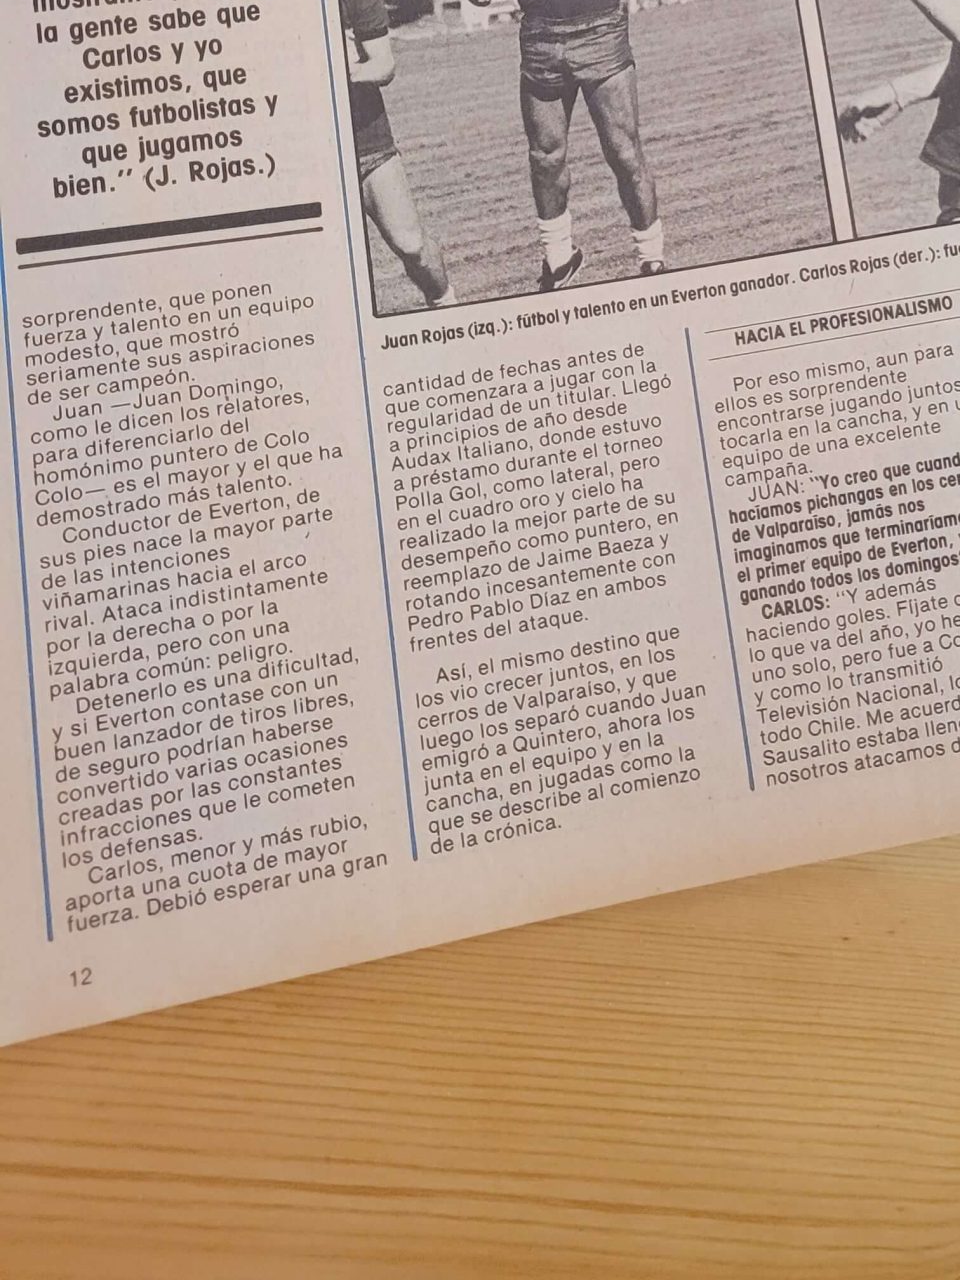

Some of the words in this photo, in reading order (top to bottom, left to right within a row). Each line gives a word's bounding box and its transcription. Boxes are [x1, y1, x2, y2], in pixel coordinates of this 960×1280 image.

[36, 22, 59, 44] la
[69, 15, 138, 46] gente
[148, 7, 206, 32] sabe
[216, 4, 261, 29] que
[82, 43, 162, 70] Carlos
[170, 41, 185, 65] y
[193, 38, 223, 62] yo
[64, 74, 192, 104] existimos,
[202, 67, 247, 93] que
[37, 112, 121, 138] somos
[128, 97, 256, 128] futbolistas
[264, 94, 278, 118] y
[81, 143, 128, 169] que
[138, 129, 243, 164] jugamos
[188, 152, 276, 184] Rojas.)
[380, 333, 419, 350] Juan
[421, 325, 465, 345] Rojas
[516, 308, 560, 330] fútbol
[561, 309, 571, 325] y
[573, 300, 626, 320] talento
[628, 297, 648, 311] en
[650, 293, 669, 308] un
[670, 284, 727, 304] Everton
[729, 272, 796, 297] ganador.
[799, 263, 848, 283] Carlos
[849, 255, 891, 274] Rojas
[734, 324, 786, 346] HACIA
[789, 320, 807, 337] EL
[809, 295, 953, 334] PROFESIONALISMO
[383, 370, 466, 397] cantidad
[471, 367, 494, 384] de
[499, 358, 561, 379] fechas
[567, 349, 617, 369] antes
[622, 343, 644, 359] de
[732, 376, 763, 392] Por
[768, 370, 800, 386] eso
[805, 359, 871, 380] mismo,
[875, 352, 909, 369] aun
[914, 344, 954, 365] para
[766, 760, 849, 787] nosotros
[854, 743, 946, 771] atacamos
[88, 858, 164, 885] Carlos,
[170, 841, 236, 868] menor
[242, 837, 254, 857] y
[260, 825, 304, 849] más
[310, 814, 368, 838] rubio,
[67, 907, 139, 933] fuerza.
[146, 887, 207, 917] Debió
[213, 872, 292, 902] esperar
[298, 864, 336, 884] una
[342, 853, 388, 879] gran
[69, 966, 93, 988] 12
